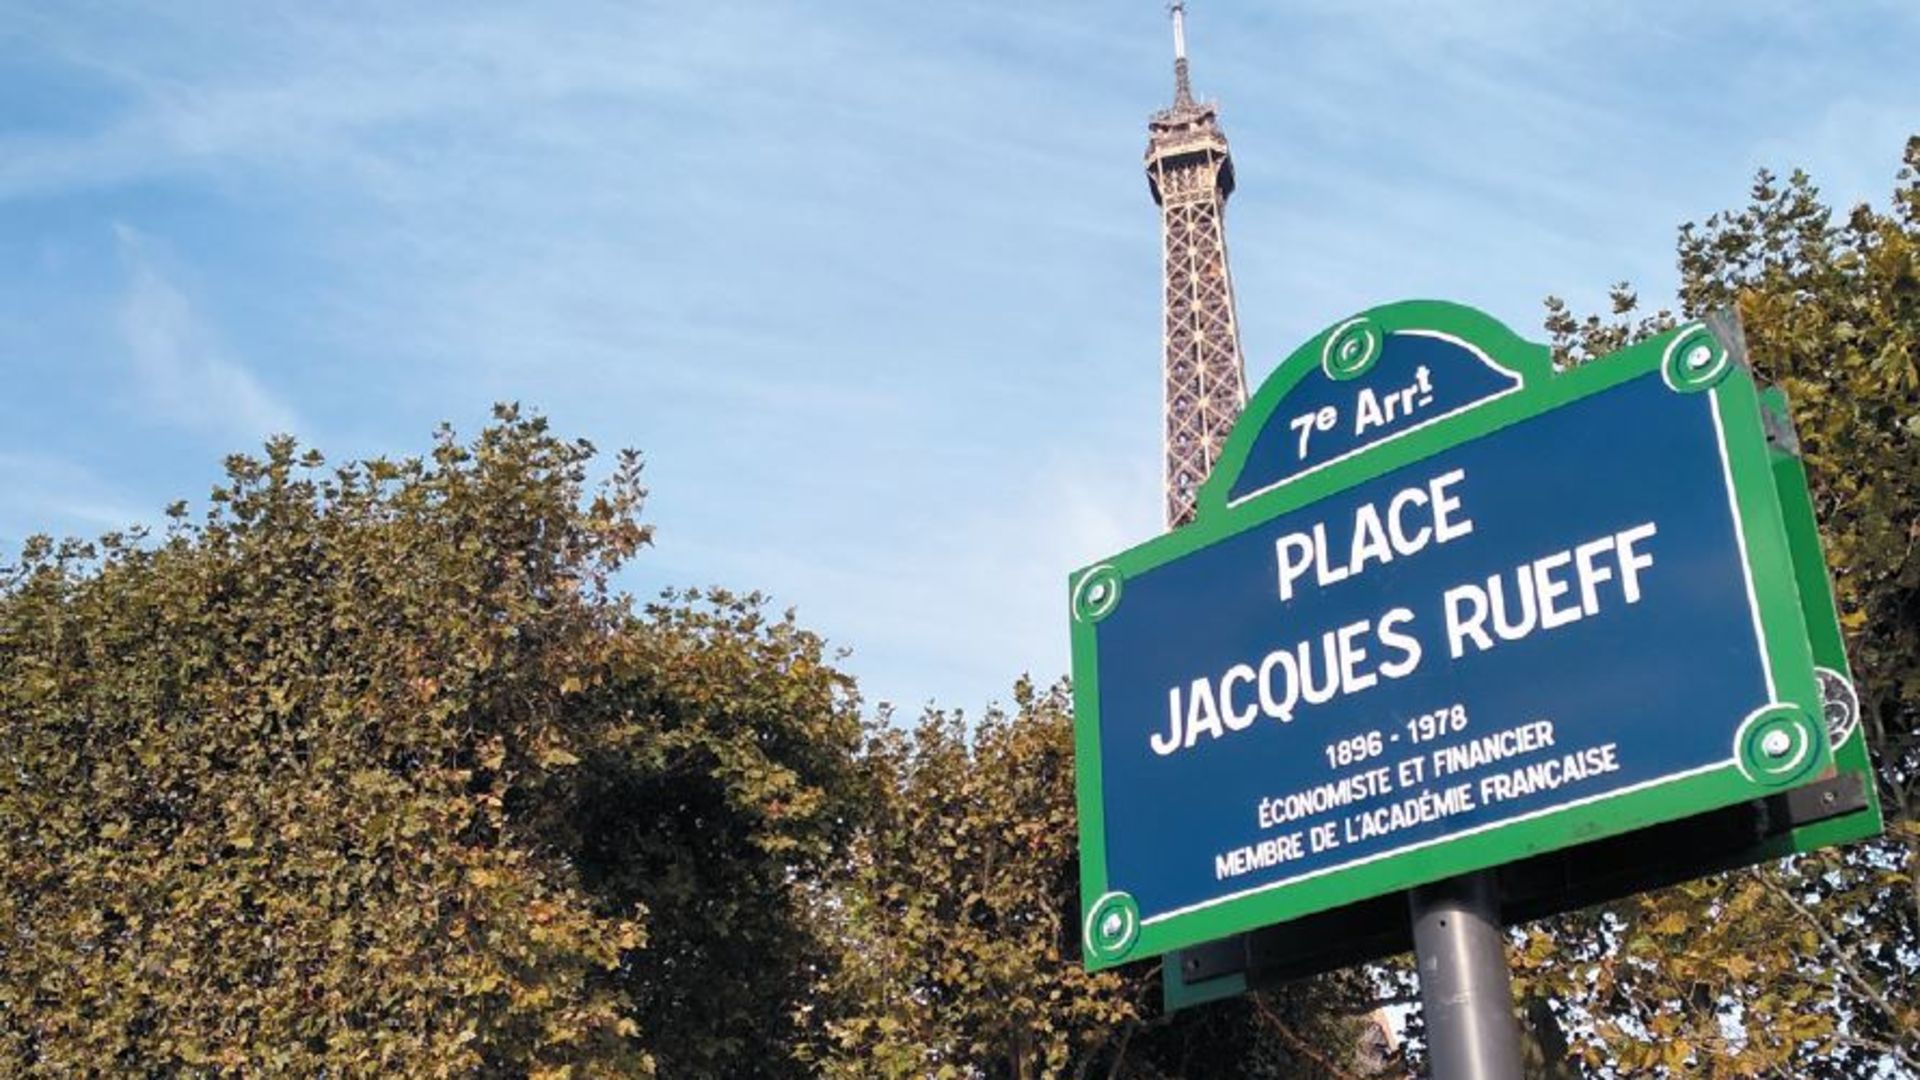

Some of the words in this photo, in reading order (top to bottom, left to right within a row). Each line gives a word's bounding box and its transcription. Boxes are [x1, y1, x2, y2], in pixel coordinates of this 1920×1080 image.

[1290, 406, 1338, 460] 7e
[1276, 468, 1473, 602] PLACE
[1150, 607, 1422, 755] JACQUES
[1444, 521, 1656, 659] RUEFF
[1258, 765, 1393, 829] ÉCONOMISTE
[1397, 756, 1426, 788] ET
[1433, 720, 1555, 778] FINANCIER
[1325, 730, 1384, 770] 1896
[1406, 704, 1468, 744] 1978
[1215, 831, 1305, 881] MEMBRE
[1310, 822, 1340, 853] DE
[1344, 783, 1476, 843] L'ACADÉMIE
